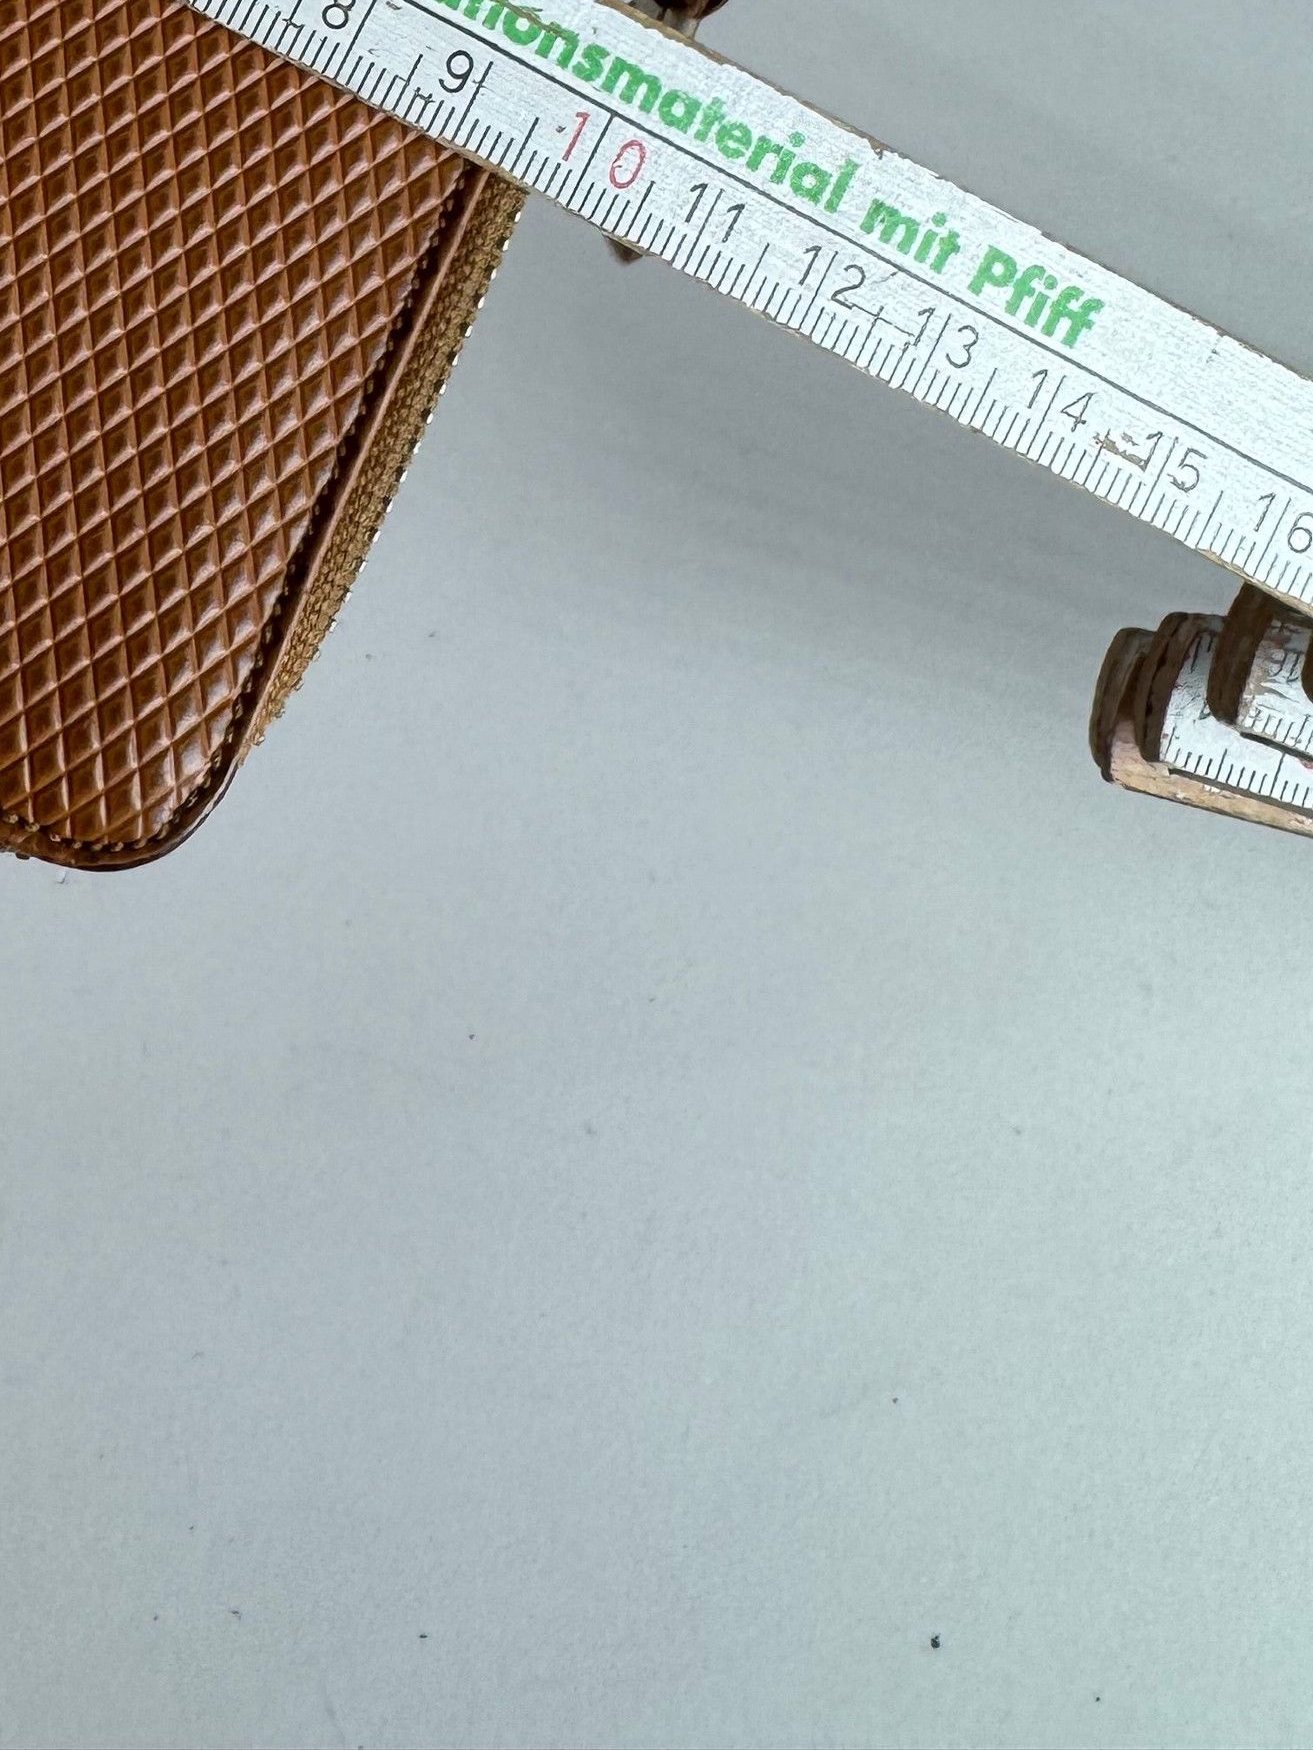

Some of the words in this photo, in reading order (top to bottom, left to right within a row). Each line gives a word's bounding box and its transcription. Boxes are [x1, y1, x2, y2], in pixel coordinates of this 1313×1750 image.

[439, 50, 474, 93] 9
[562, 111, 647, 190] 10
[688, 182, 746, 243] 11
[798, 245, 866, 309] 12
[910, 306, 980, 369] 13
[1024, 368, 1095, 432] 14
[1139, 430, 1207, 492] 15
[1253, 492, 1313, 553] 16
[860, 199, 960, 274] mit
[968, 245, 1104, 348] Pfiff
